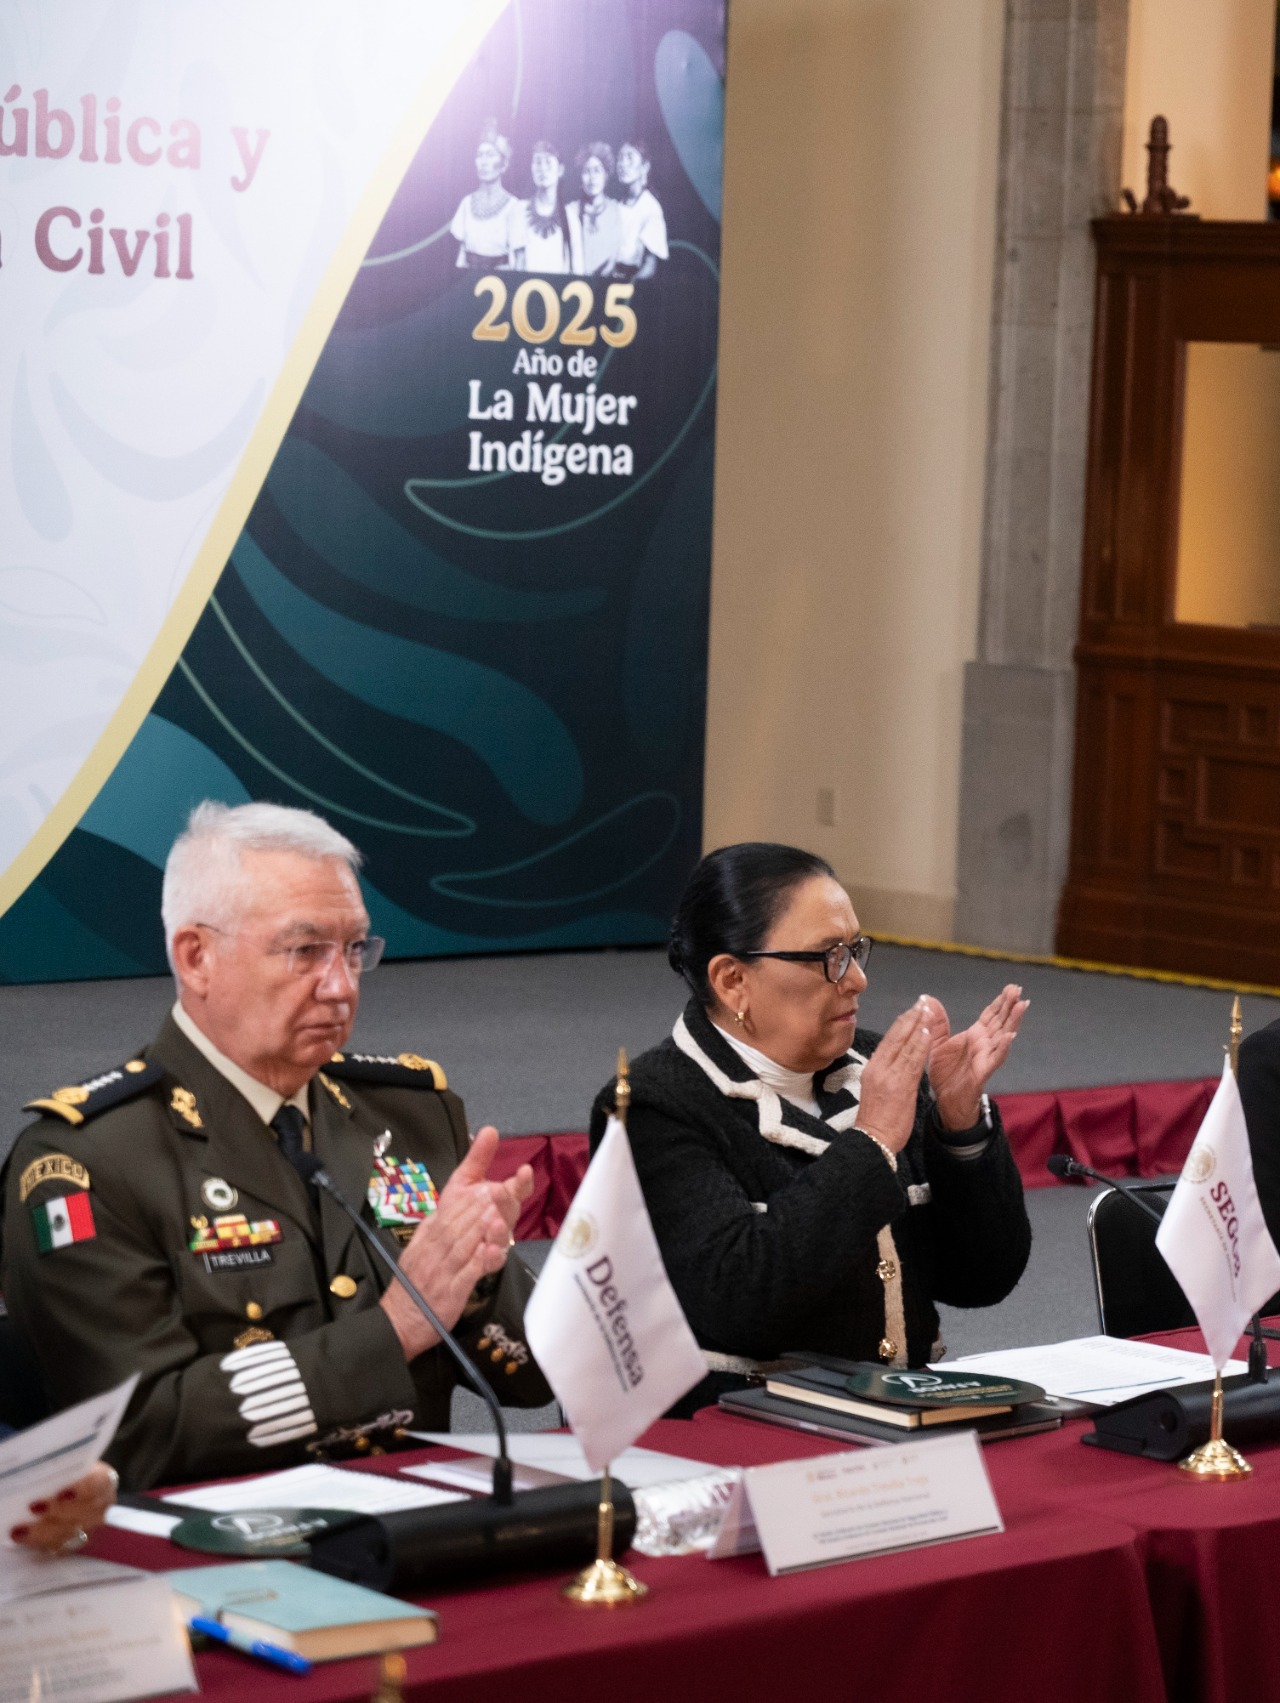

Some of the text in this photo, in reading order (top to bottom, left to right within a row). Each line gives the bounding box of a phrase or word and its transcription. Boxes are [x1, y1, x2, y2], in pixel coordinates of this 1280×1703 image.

[229, 126, 271, 193] y
[34, 206, 194, 280] Civil
[472, 275, 638, 348] 2025
[512, 347, 598, 377] Año de
[468, 379, 638, 435] La Mujer
[468, 429, 634, 486] Indígena
[25, 1158, 83, 1188] MEXICO
[210, 1248, 271, 1267] TREVILLA
[585, 1255, 646, 1388] Defensa
